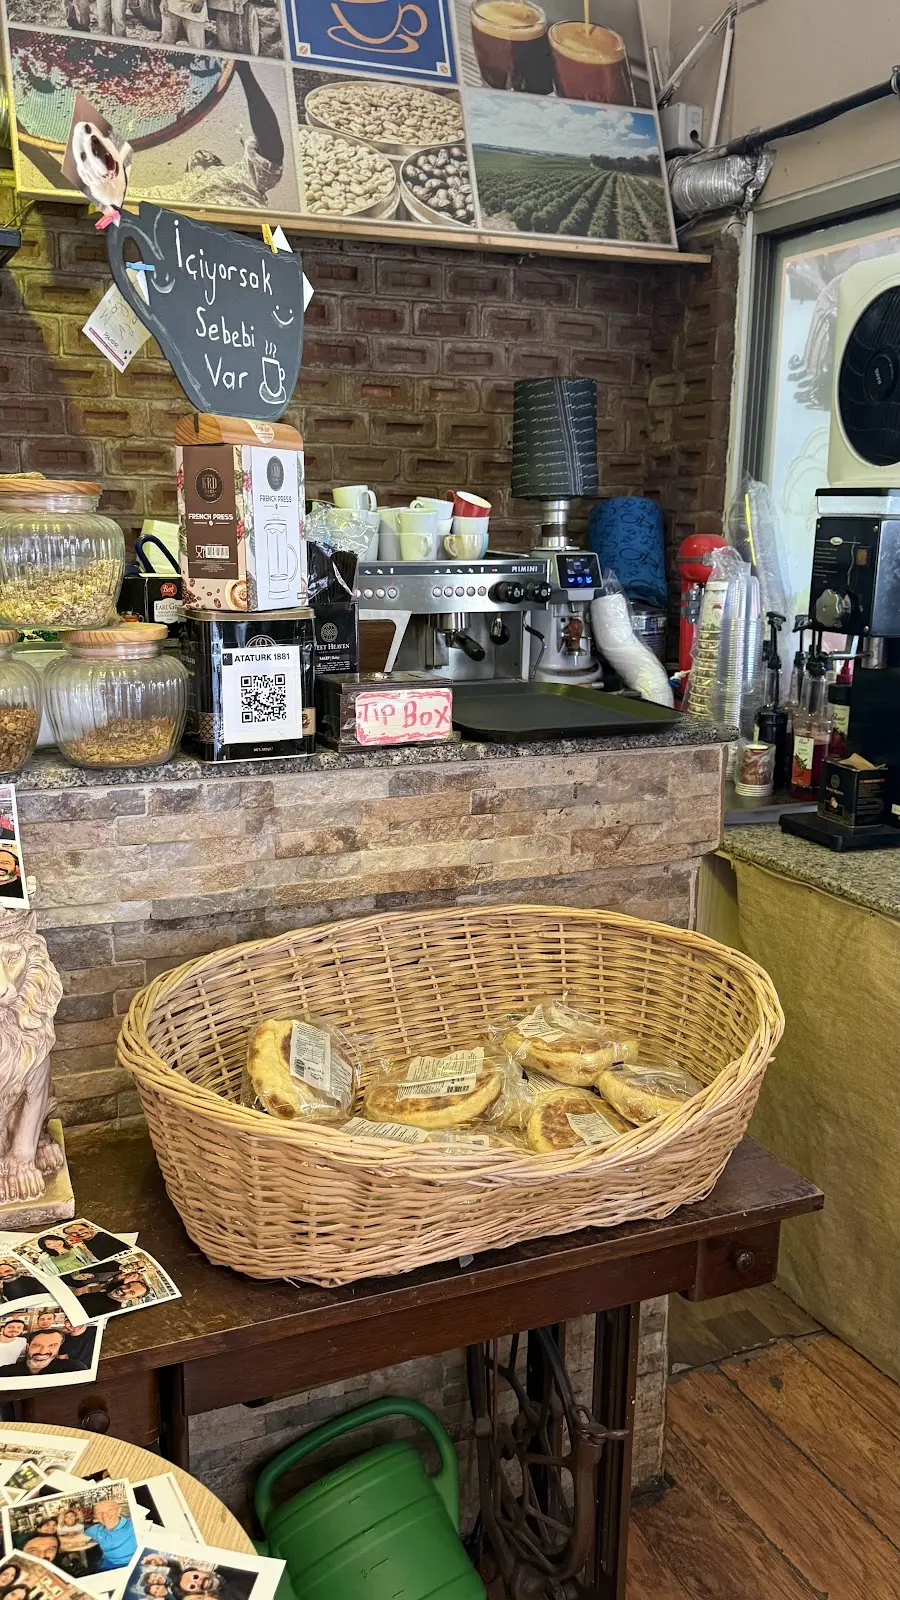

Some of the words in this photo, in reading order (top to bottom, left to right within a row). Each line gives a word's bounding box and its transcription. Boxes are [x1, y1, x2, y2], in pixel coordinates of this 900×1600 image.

[174, 219, 273, 306] İçiyorsak
[195, 306, 255, 348] Sebebi
[204, 353, 249, 390] Var
[259, 494, 277, 503] FRENCH
[277, 495, 292, 503] PRESS
[511, 565, 538, 573] RIMINI
[234, 653, 272, 663] ATATURK
[273, 652, 290, 661] 1881
